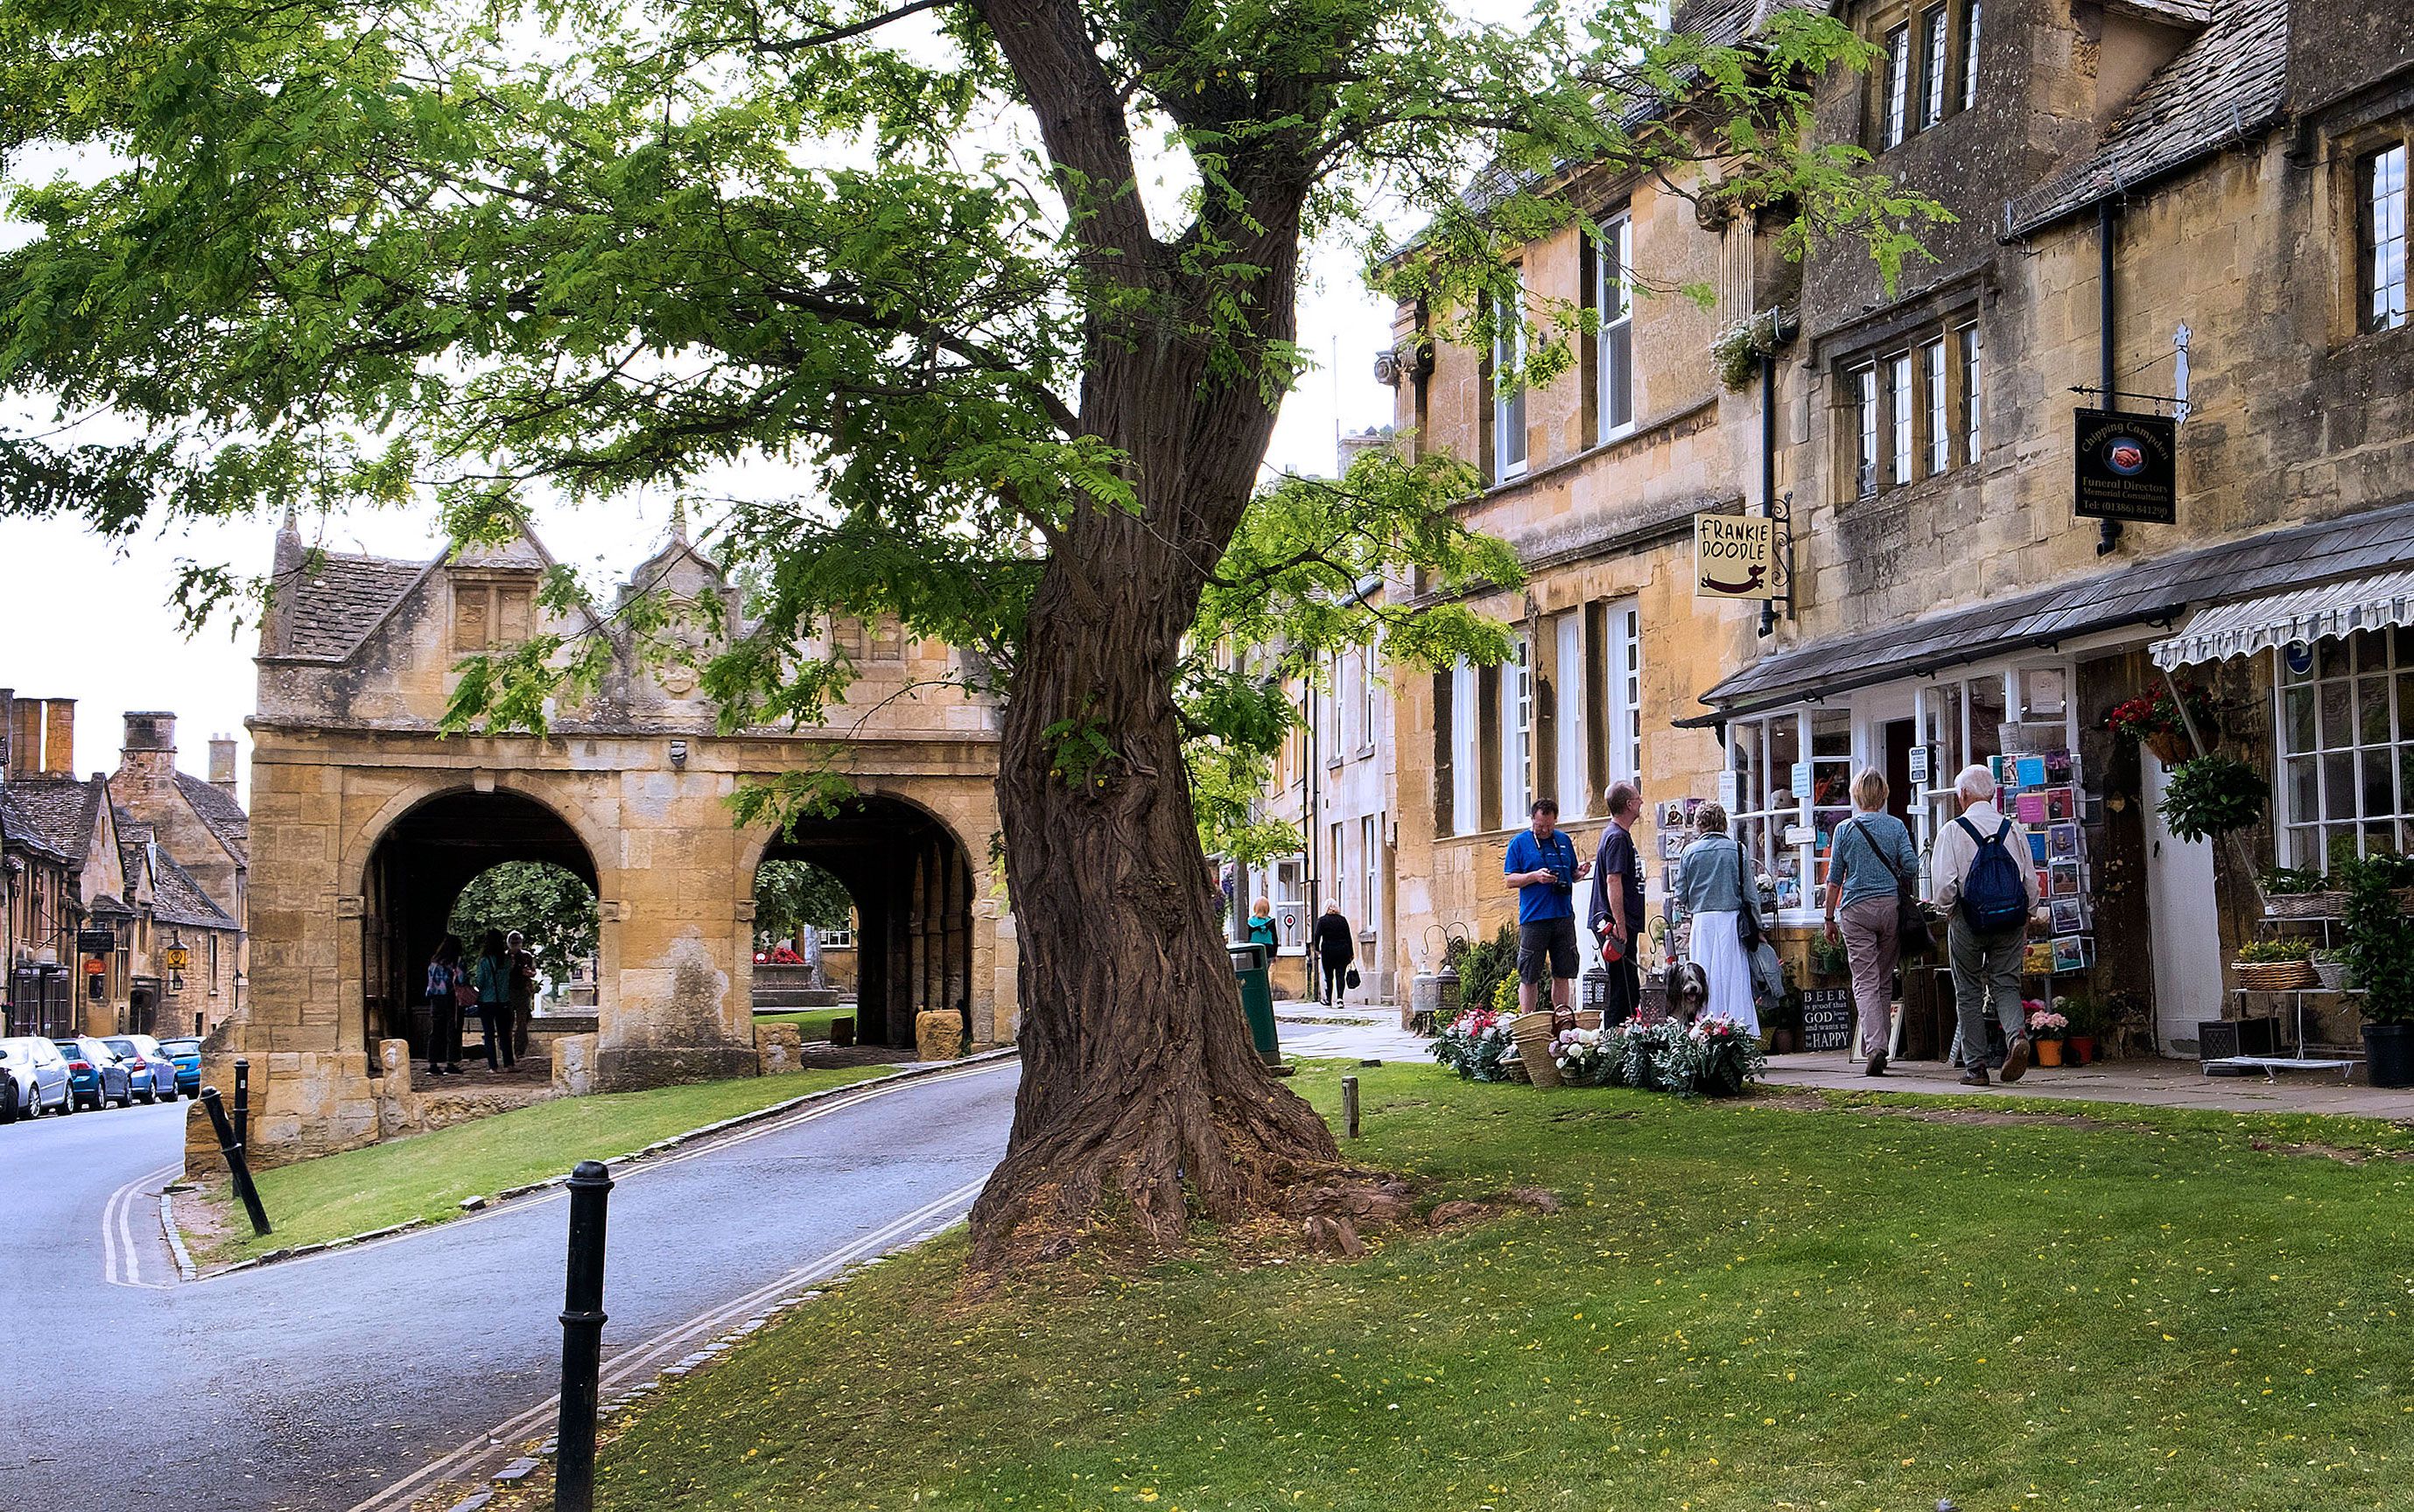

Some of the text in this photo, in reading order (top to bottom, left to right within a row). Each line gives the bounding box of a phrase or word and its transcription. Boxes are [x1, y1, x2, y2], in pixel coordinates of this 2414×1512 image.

[2082, 422, 2169, 460] Chipping Campden
[2083, 477, 2168, 493] Funeral Directors
[2083, 487, 2168, 501] Memorial Consultants
[2083, 500, 2168, 516] Tel: (01386) 841290
[1700, 519, 1769, 542] FRANKIE
[1702, 540, 1765, 560] DOODLE
[1804, 990, 1847, 1003] BEER
[1812, 1002, 1832, 1012] proof
[1804, 1012, 1833, 1024] GOD
[1813, 1032, 1849, 1048] HAPPY
